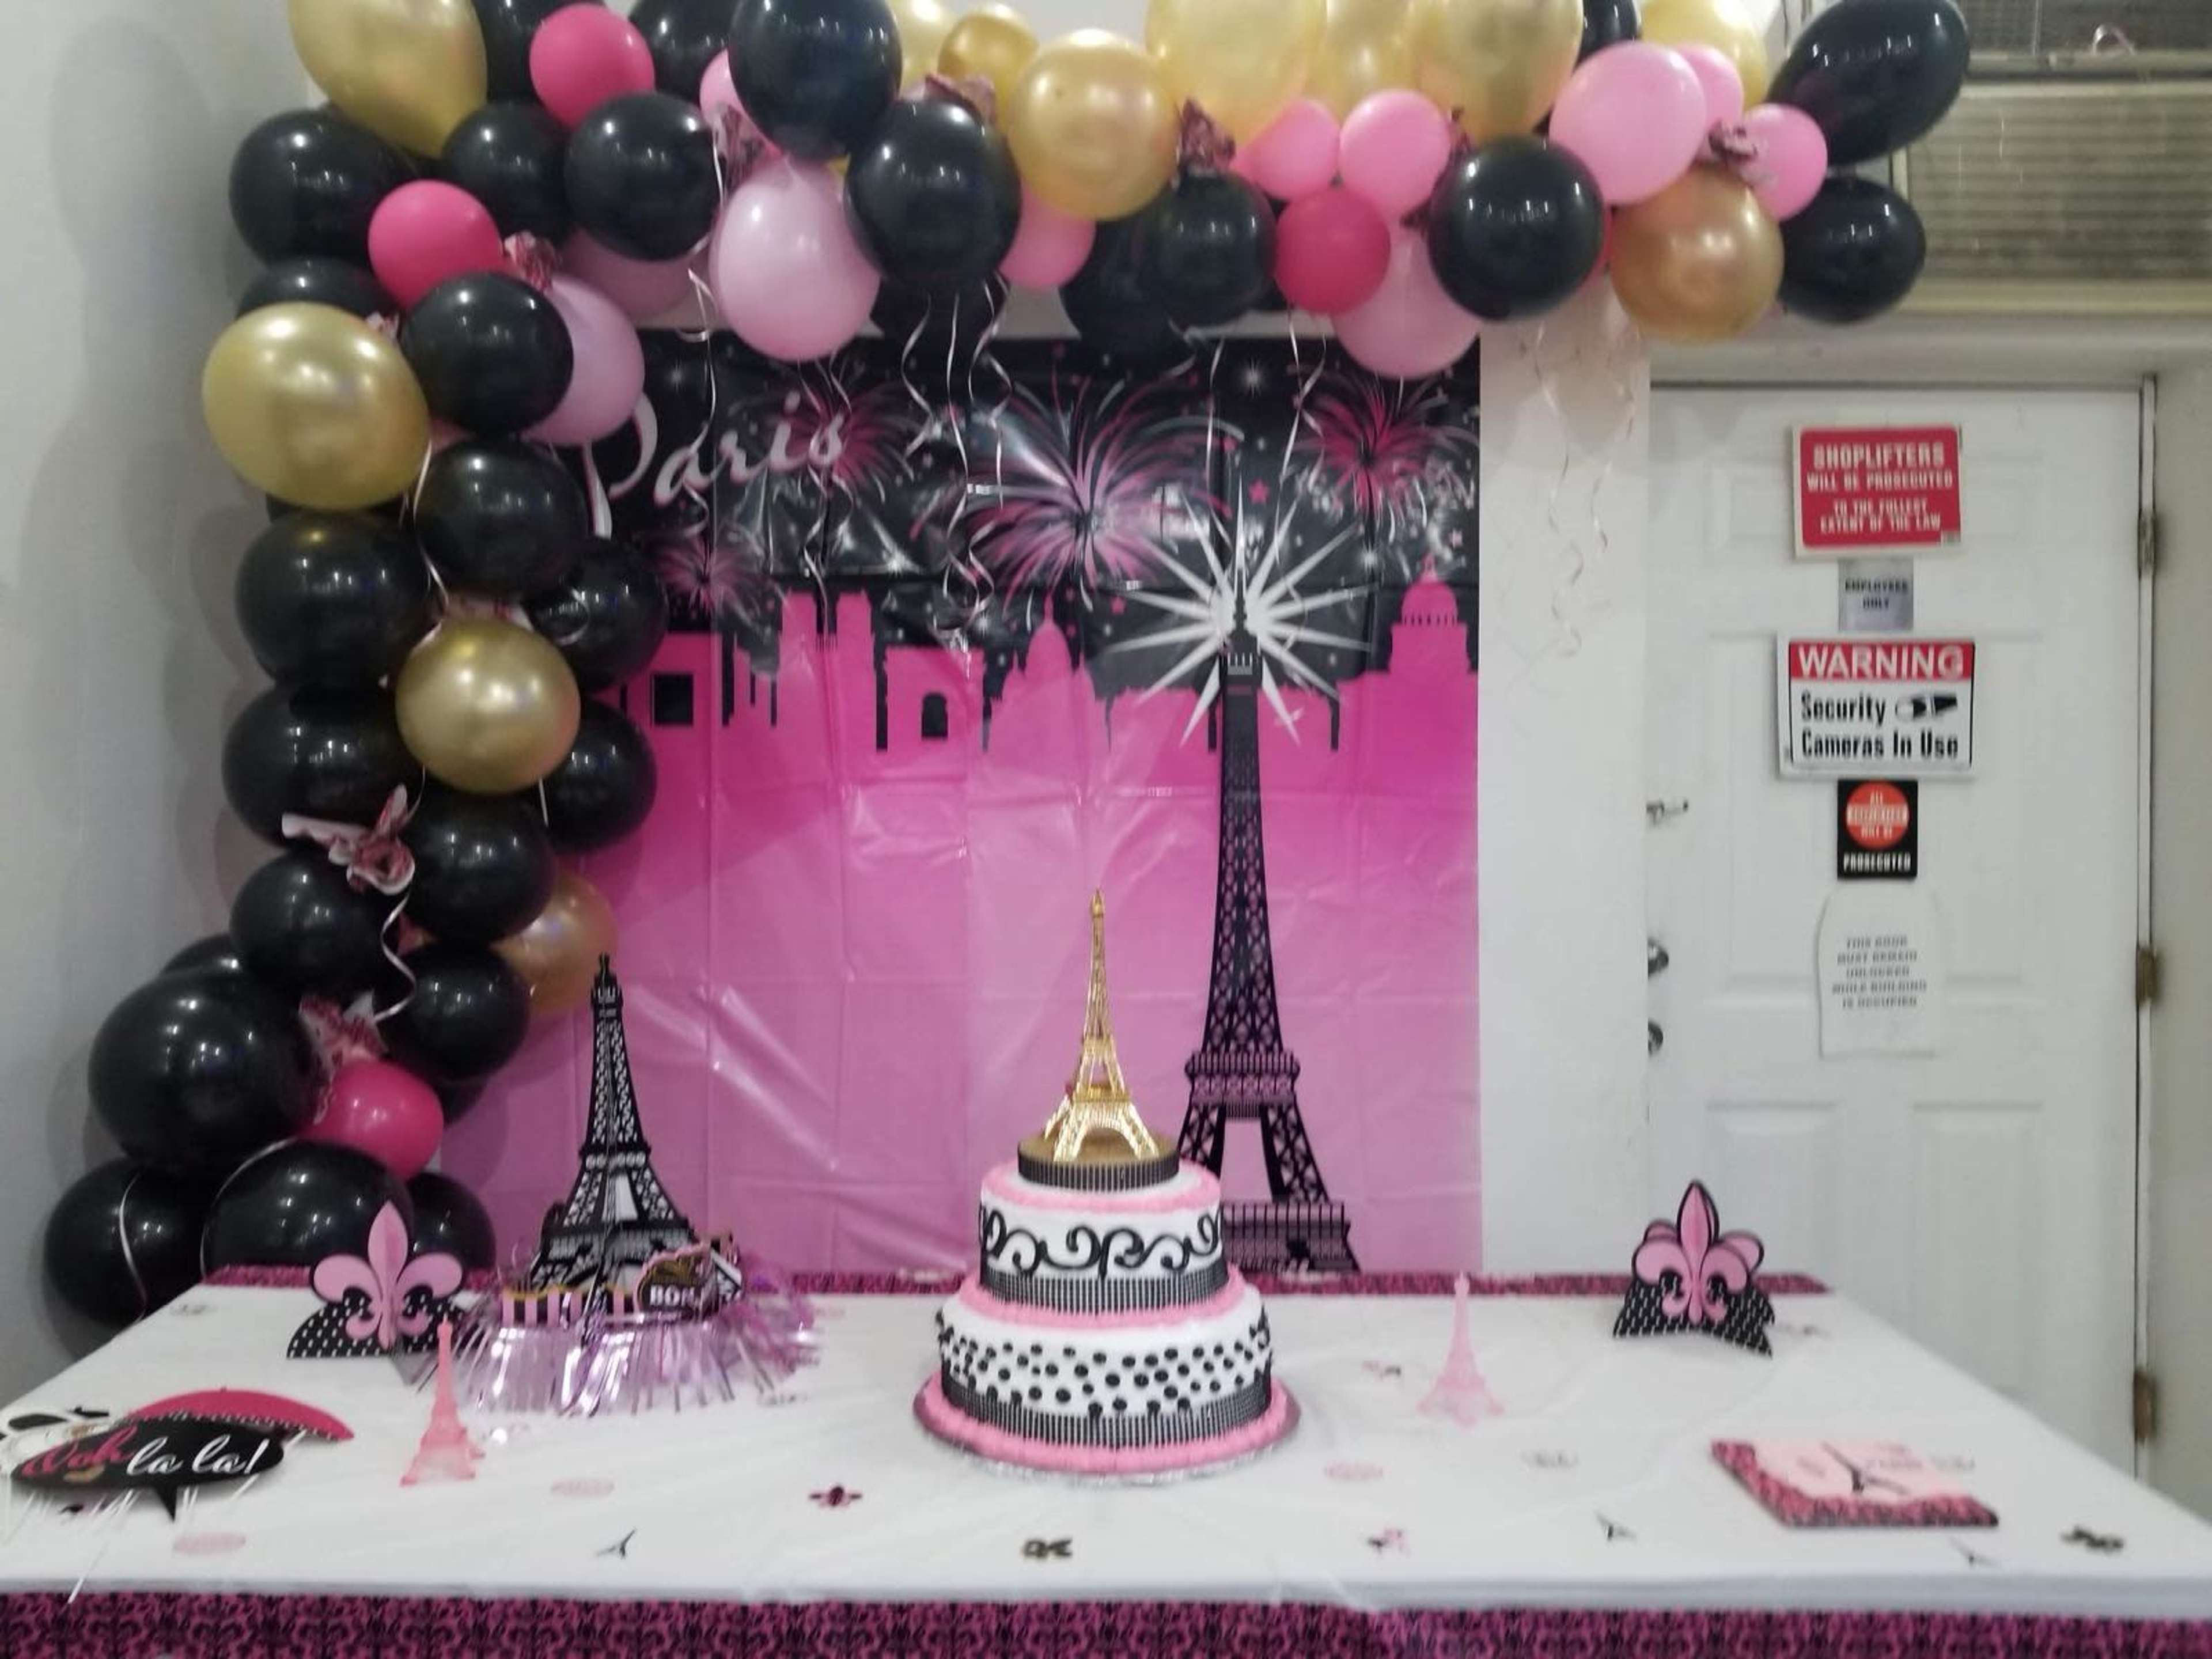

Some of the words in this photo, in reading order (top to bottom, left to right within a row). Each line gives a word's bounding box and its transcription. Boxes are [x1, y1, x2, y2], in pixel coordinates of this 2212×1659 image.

[1813, 442, 1944, 469] SHOPLIFTERS
[1806, 472, 1836, 492] WILL
[1844, 471, 1859, 491] BE
[1866, 469, 1952, 491] PROSECUTED
[1878, 497, 1927, 517] FULLEST
[1820, 516, 1865, 534] EXTENT
[1915, 514, 1941, 531] LAW
[1798, 645, 1963, 679] WARNING
[1801, 690, 1885, 726] Security
[1802, 728, 1884, 757] Cameras
[1893, 730, 1911, 757] In
[1921, 728, 1958, 757] Use
